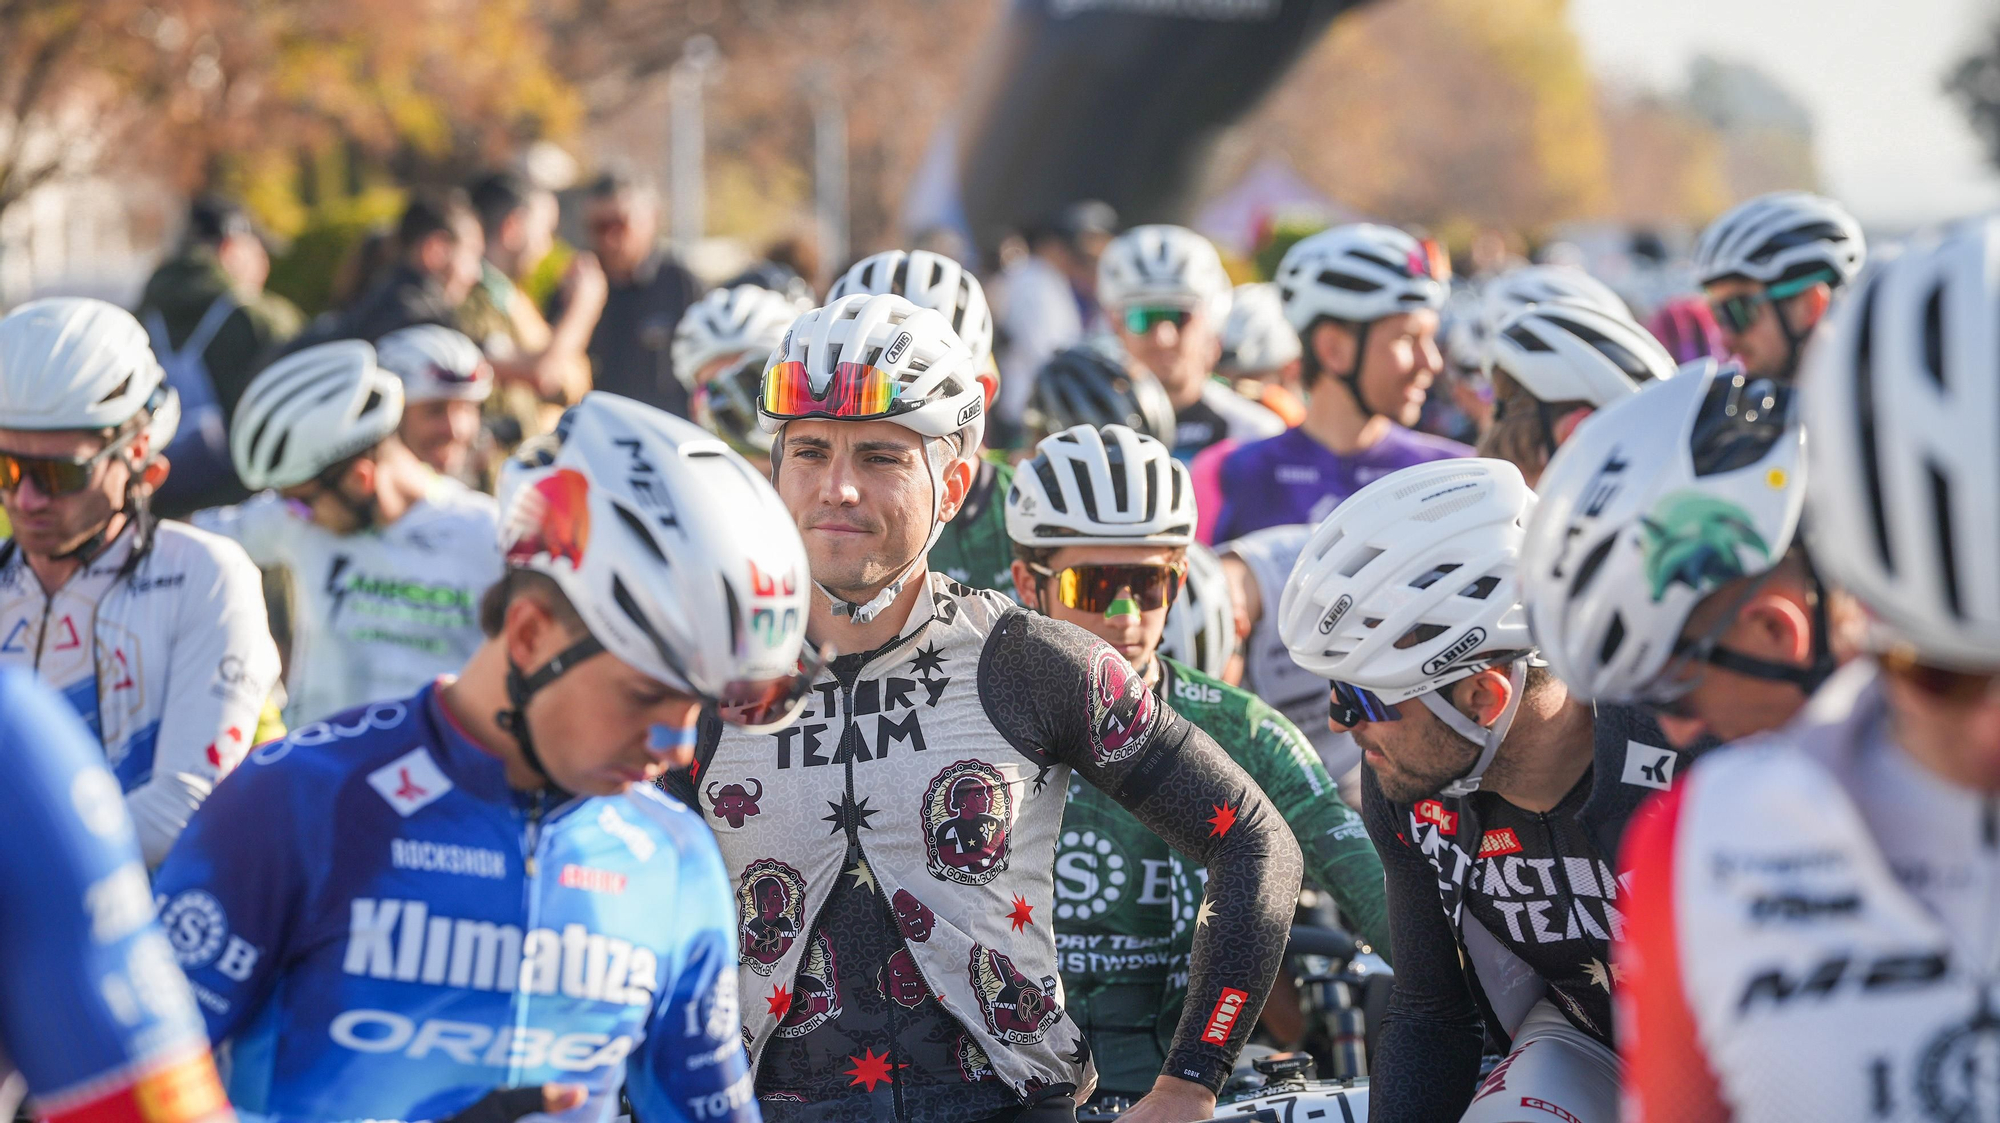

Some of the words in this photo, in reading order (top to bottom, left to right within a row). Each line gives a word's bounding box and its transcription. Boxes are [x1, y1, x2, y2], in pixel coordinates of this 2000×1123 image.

[889, 334, 911, 360] ABUS
[961, 400, 981, 422] ABUS
[1323, 598, 1349, 631] ABUS
[1430, 632, 1480, 671] ABUS
[1174, 677, 1222, 703] töls
[770, 709, 927, 770] TEAM
[1113, 741, 1142, 760] GOBIK
[790, 1014, 823, 1037] GOBIK
[1207, 993, 1243, 1041] GOBIK
[330, 1008, 634, 1072] ORBEA
[1183, 1068, 1201, 1079] GOBIK
